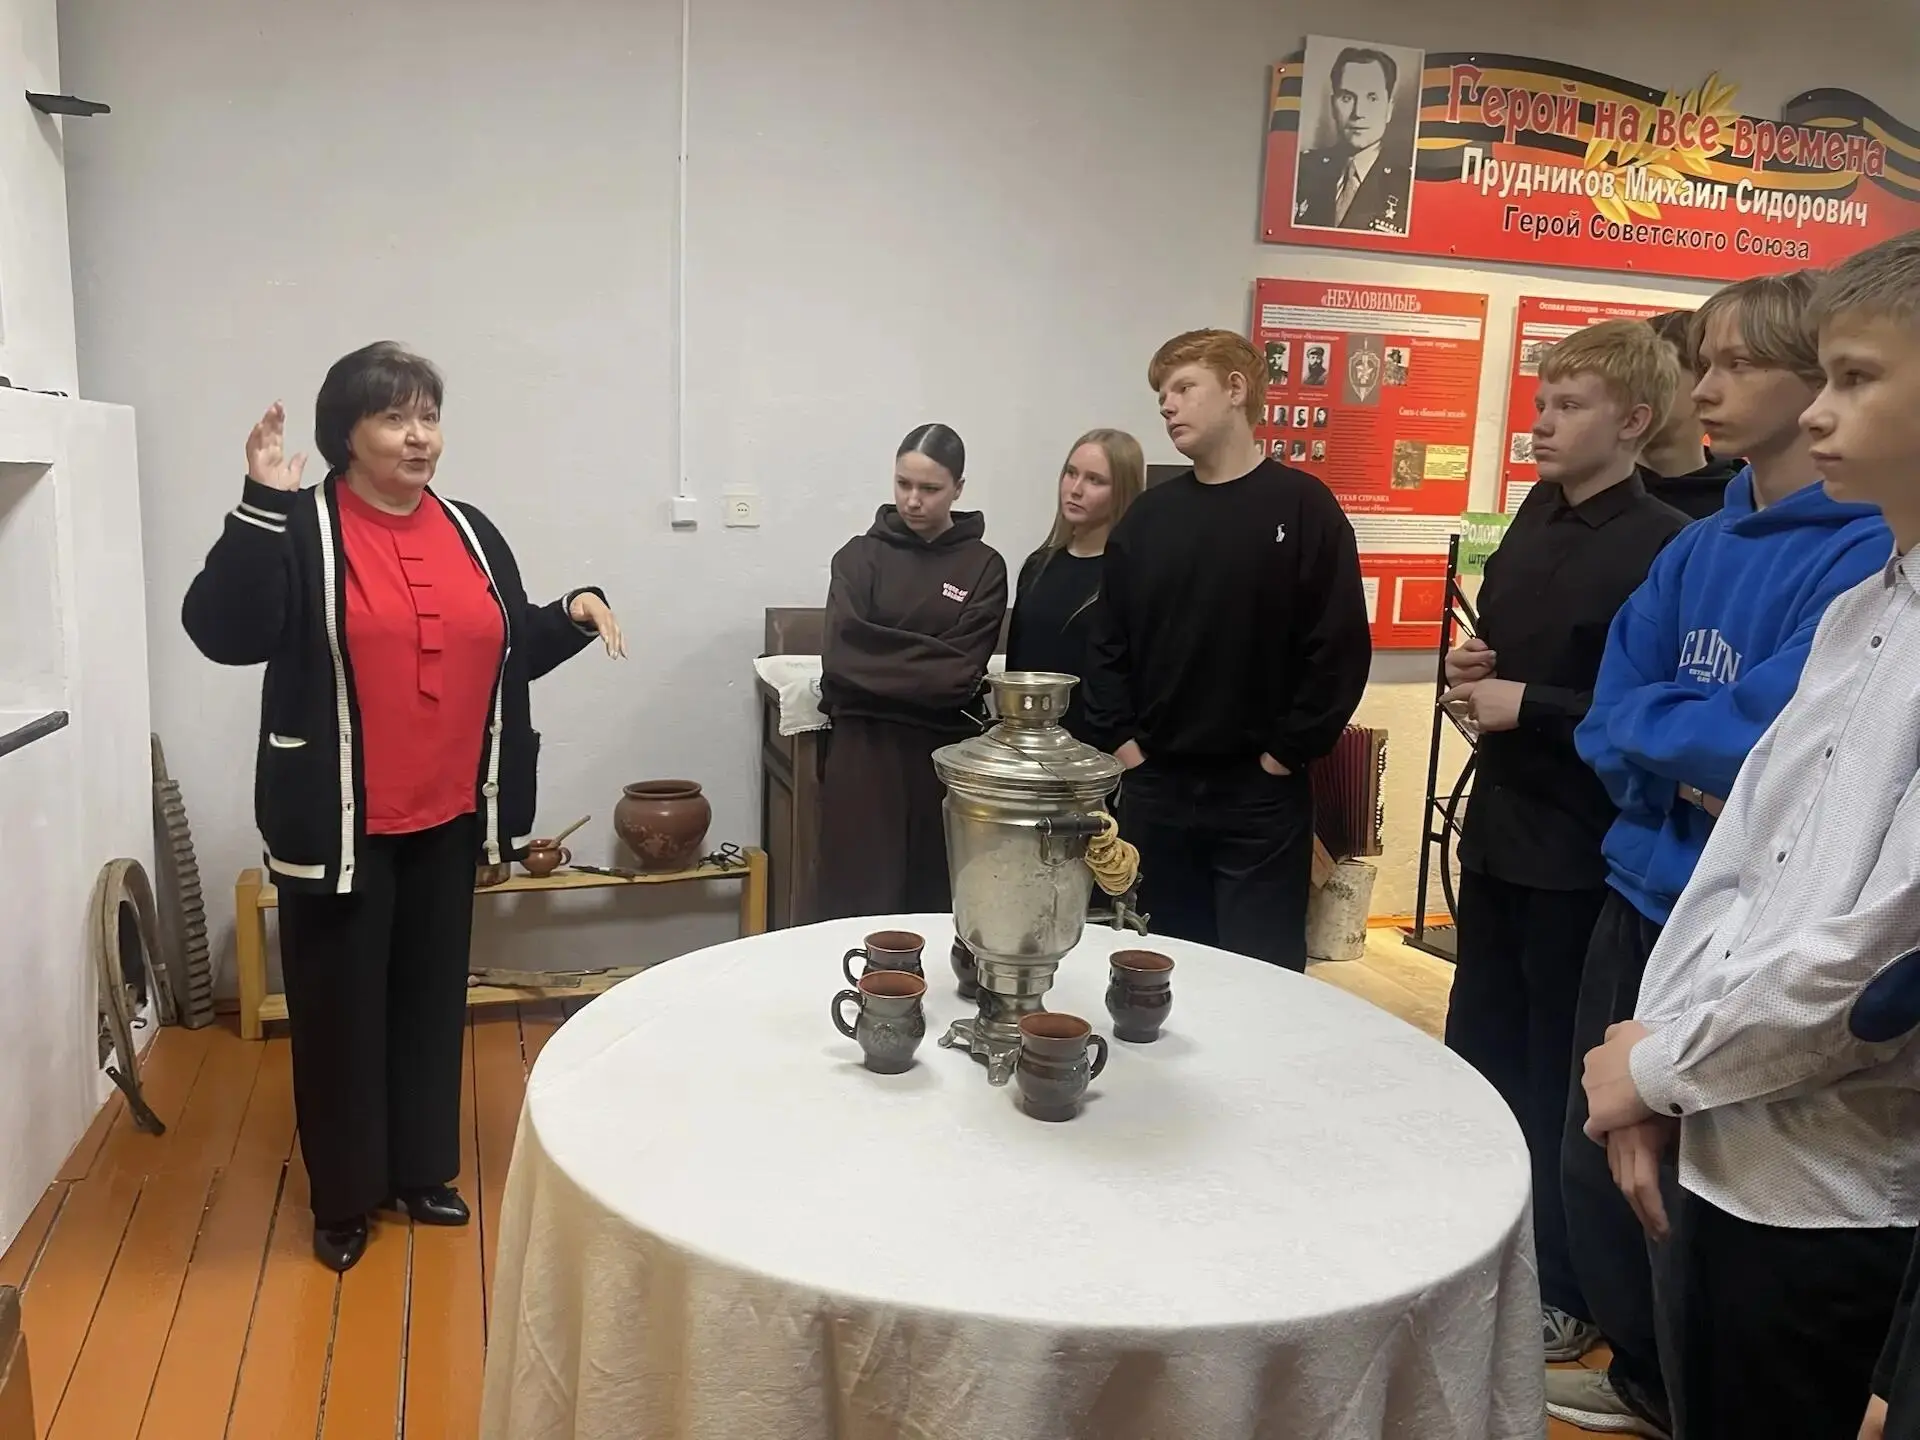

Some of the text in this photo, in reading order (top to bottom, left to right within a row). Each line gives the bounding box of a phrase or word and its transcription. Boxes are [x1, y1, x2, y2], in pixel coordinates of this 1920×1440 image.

[1446, 64, 1887, 177] Герой на все времена
[1460, 147, 1868, 228] Прудников Михаил Сидорович
[1503, 205, 1809, 260] Герой Советского Союза
[1321, 288, 1422, 312] «НЕУЛОВИМЫЕ»
